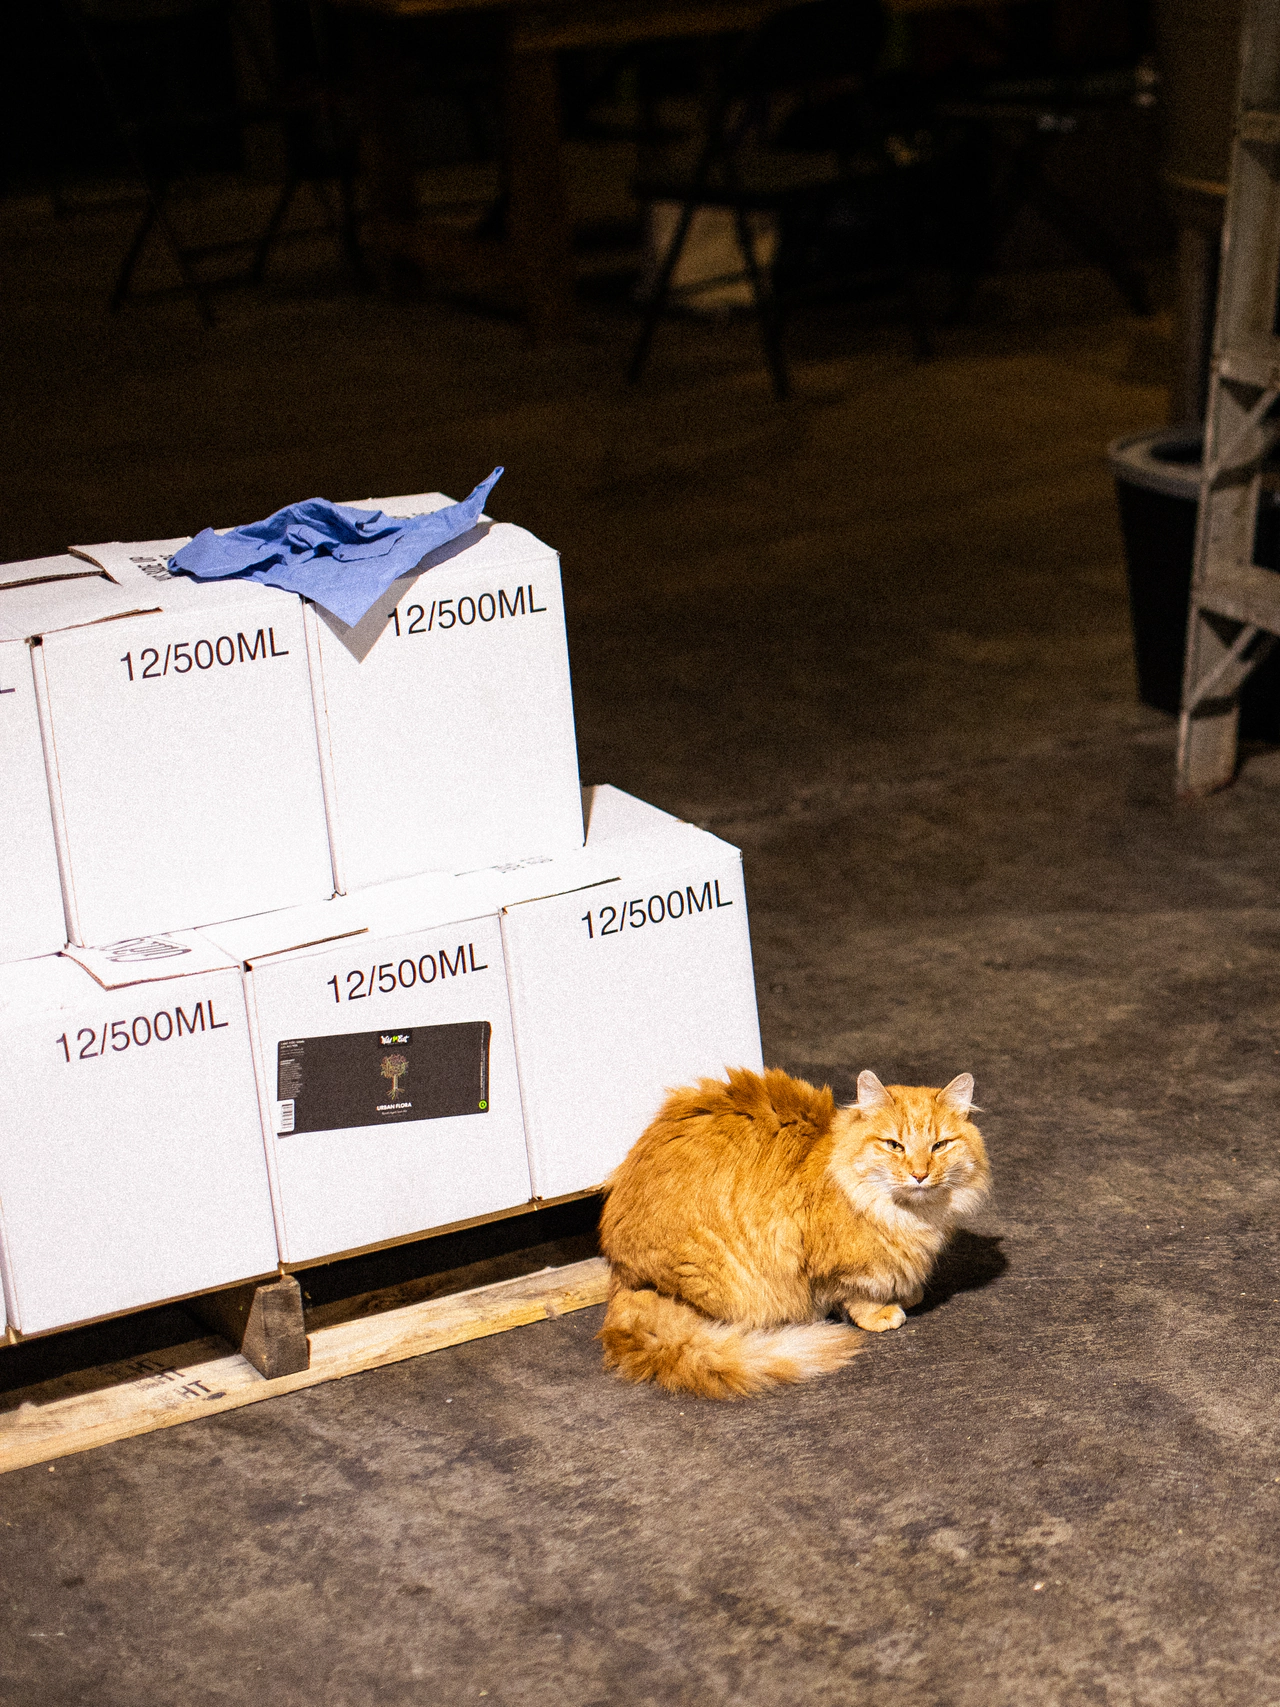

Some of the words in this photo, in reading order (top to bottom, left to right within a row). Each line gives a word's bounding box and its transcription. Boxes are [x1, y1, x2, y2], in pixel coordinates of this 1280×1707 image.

[387, 584, 547, 637] 12/500ML
[121, 627, 289, 681] 12/500ML
[581, 879, 733, 939] 12/500ML
[327, 943, 488, 1003] 12/500ML
[56, 1000, 228, 1062] 12/500ML
